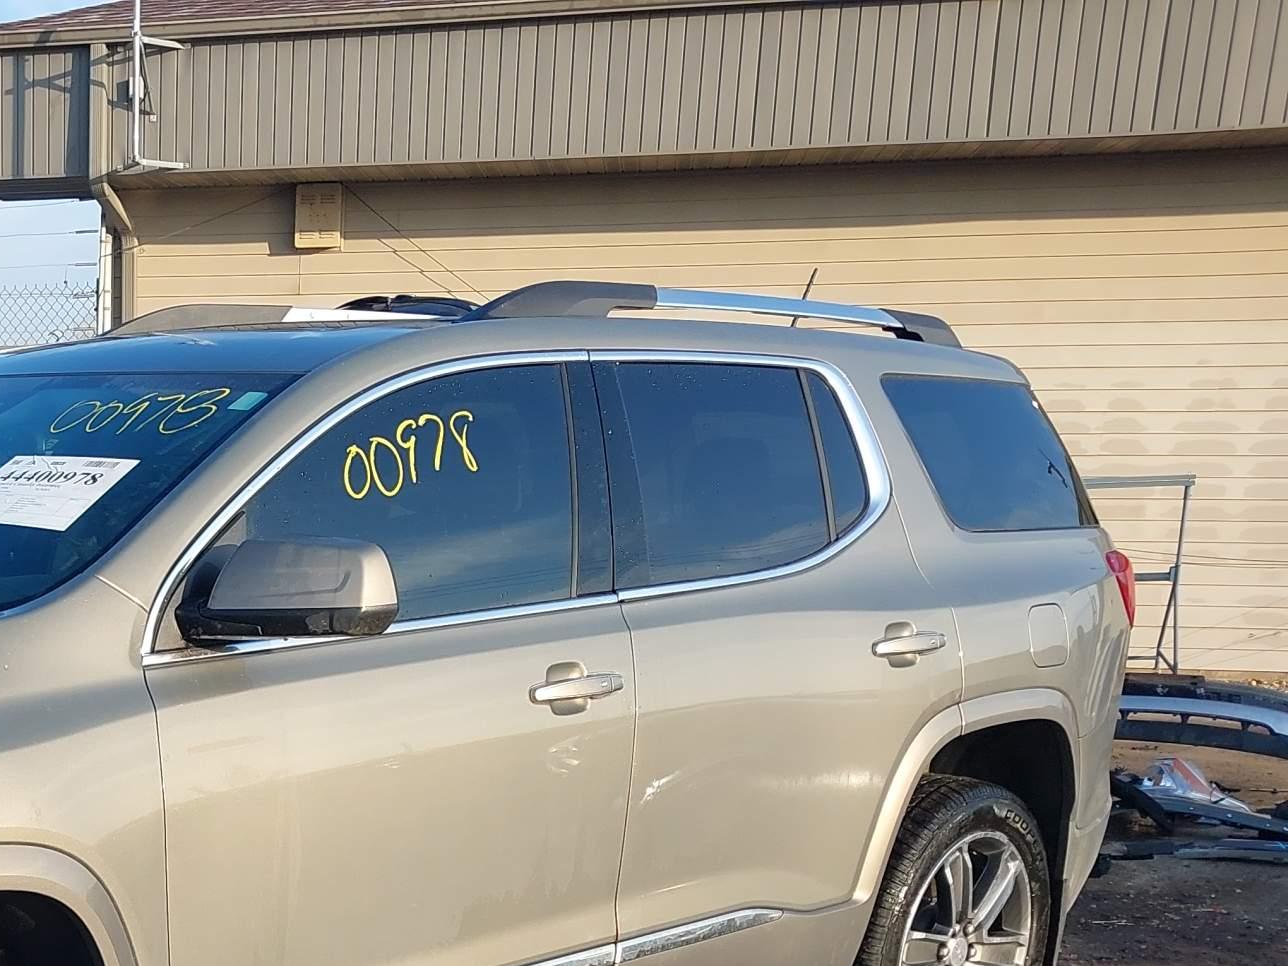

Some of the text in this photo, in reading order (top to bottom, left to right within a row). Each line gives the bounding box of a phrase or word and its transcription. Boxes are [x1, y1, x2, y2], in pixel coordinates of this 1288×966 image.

[48, 387, 232, 435] 00978
[0, 469, 105, 487] 44400978
[342, 409, 479, 500] 00978
